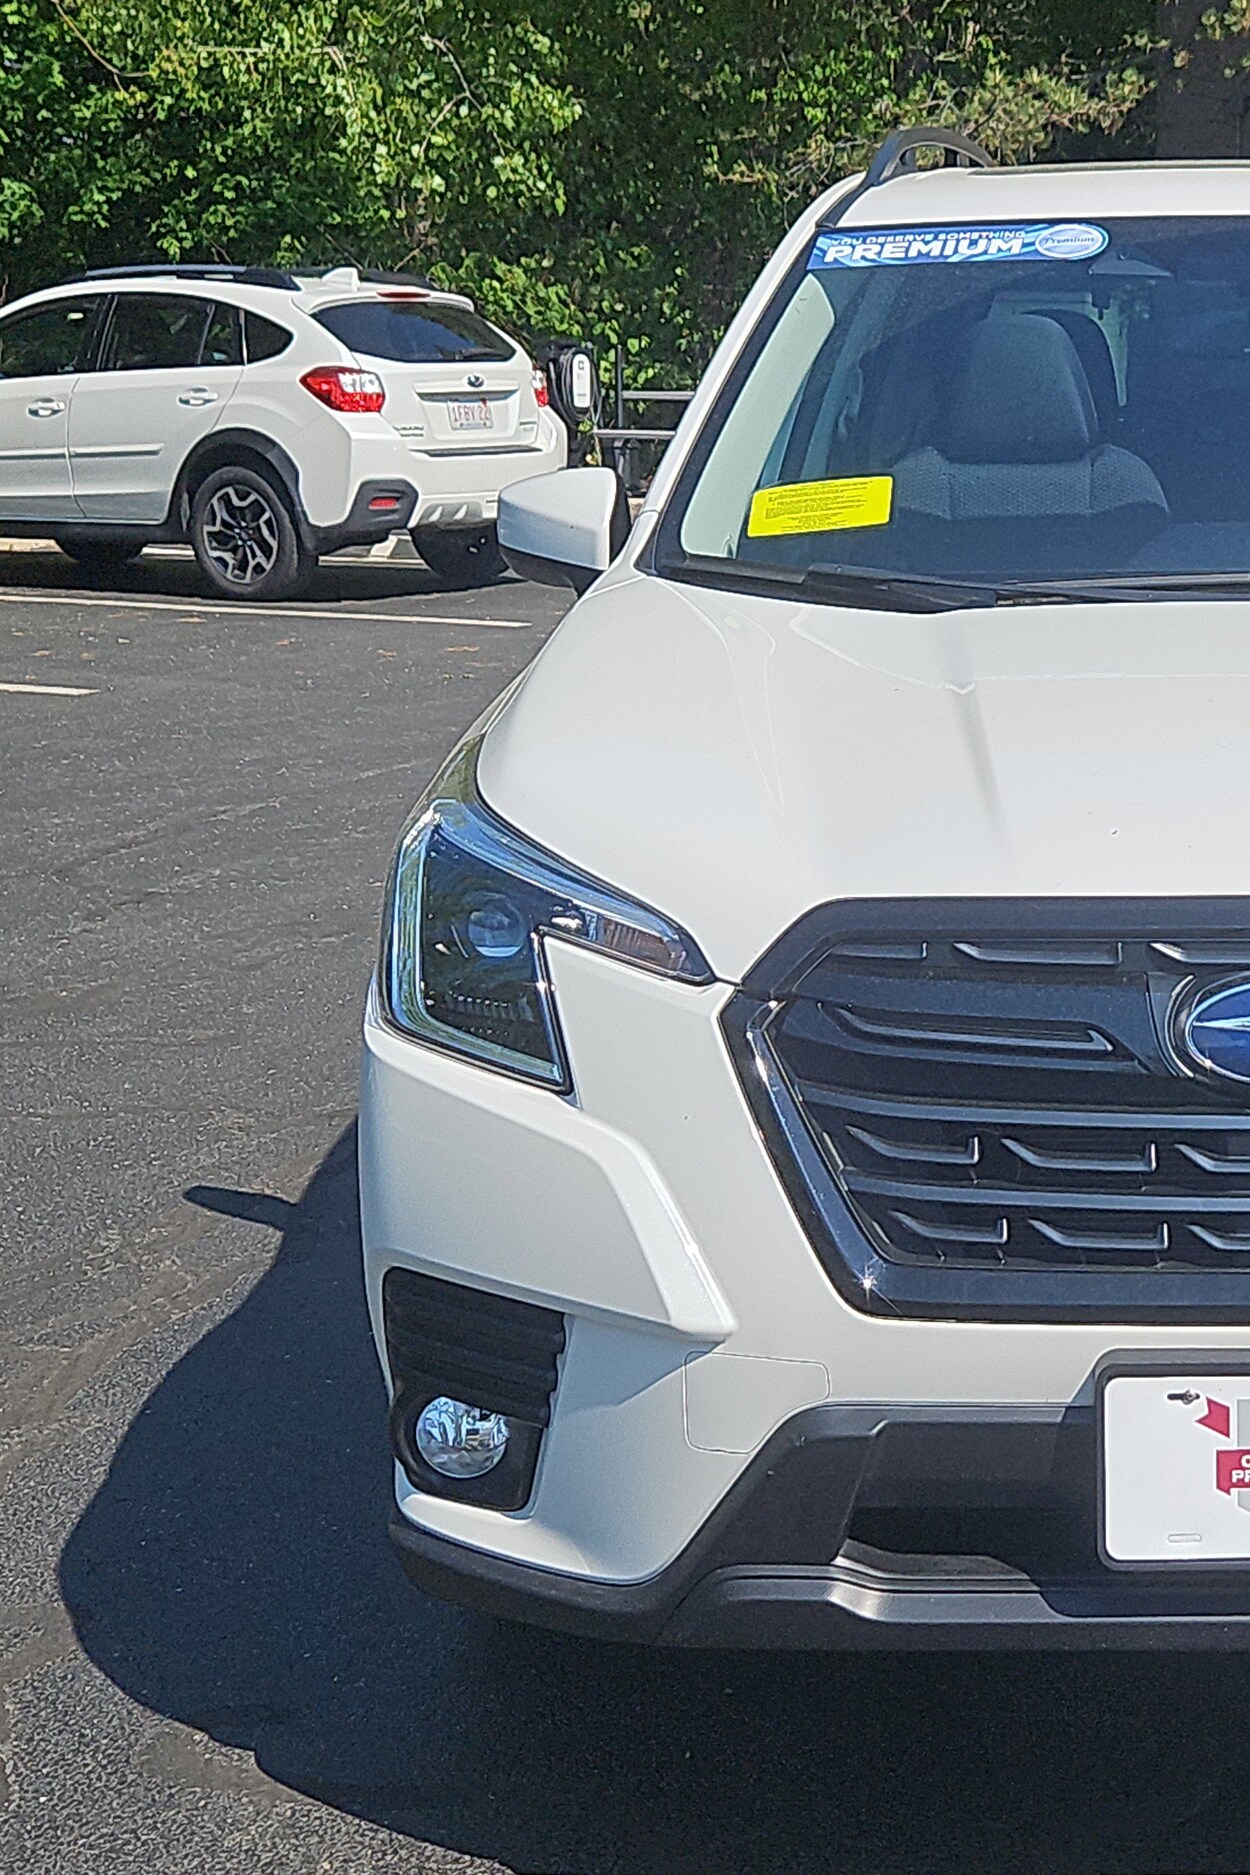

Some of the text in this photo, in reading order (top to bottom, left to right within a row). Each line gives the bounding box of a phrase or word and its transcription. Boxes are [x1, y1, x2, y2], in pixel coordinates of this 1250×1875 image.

[831, 230, 1026, 246] YOU DESERVE SOMETHING
[823, 237, 1024, 262] PREMIUM
